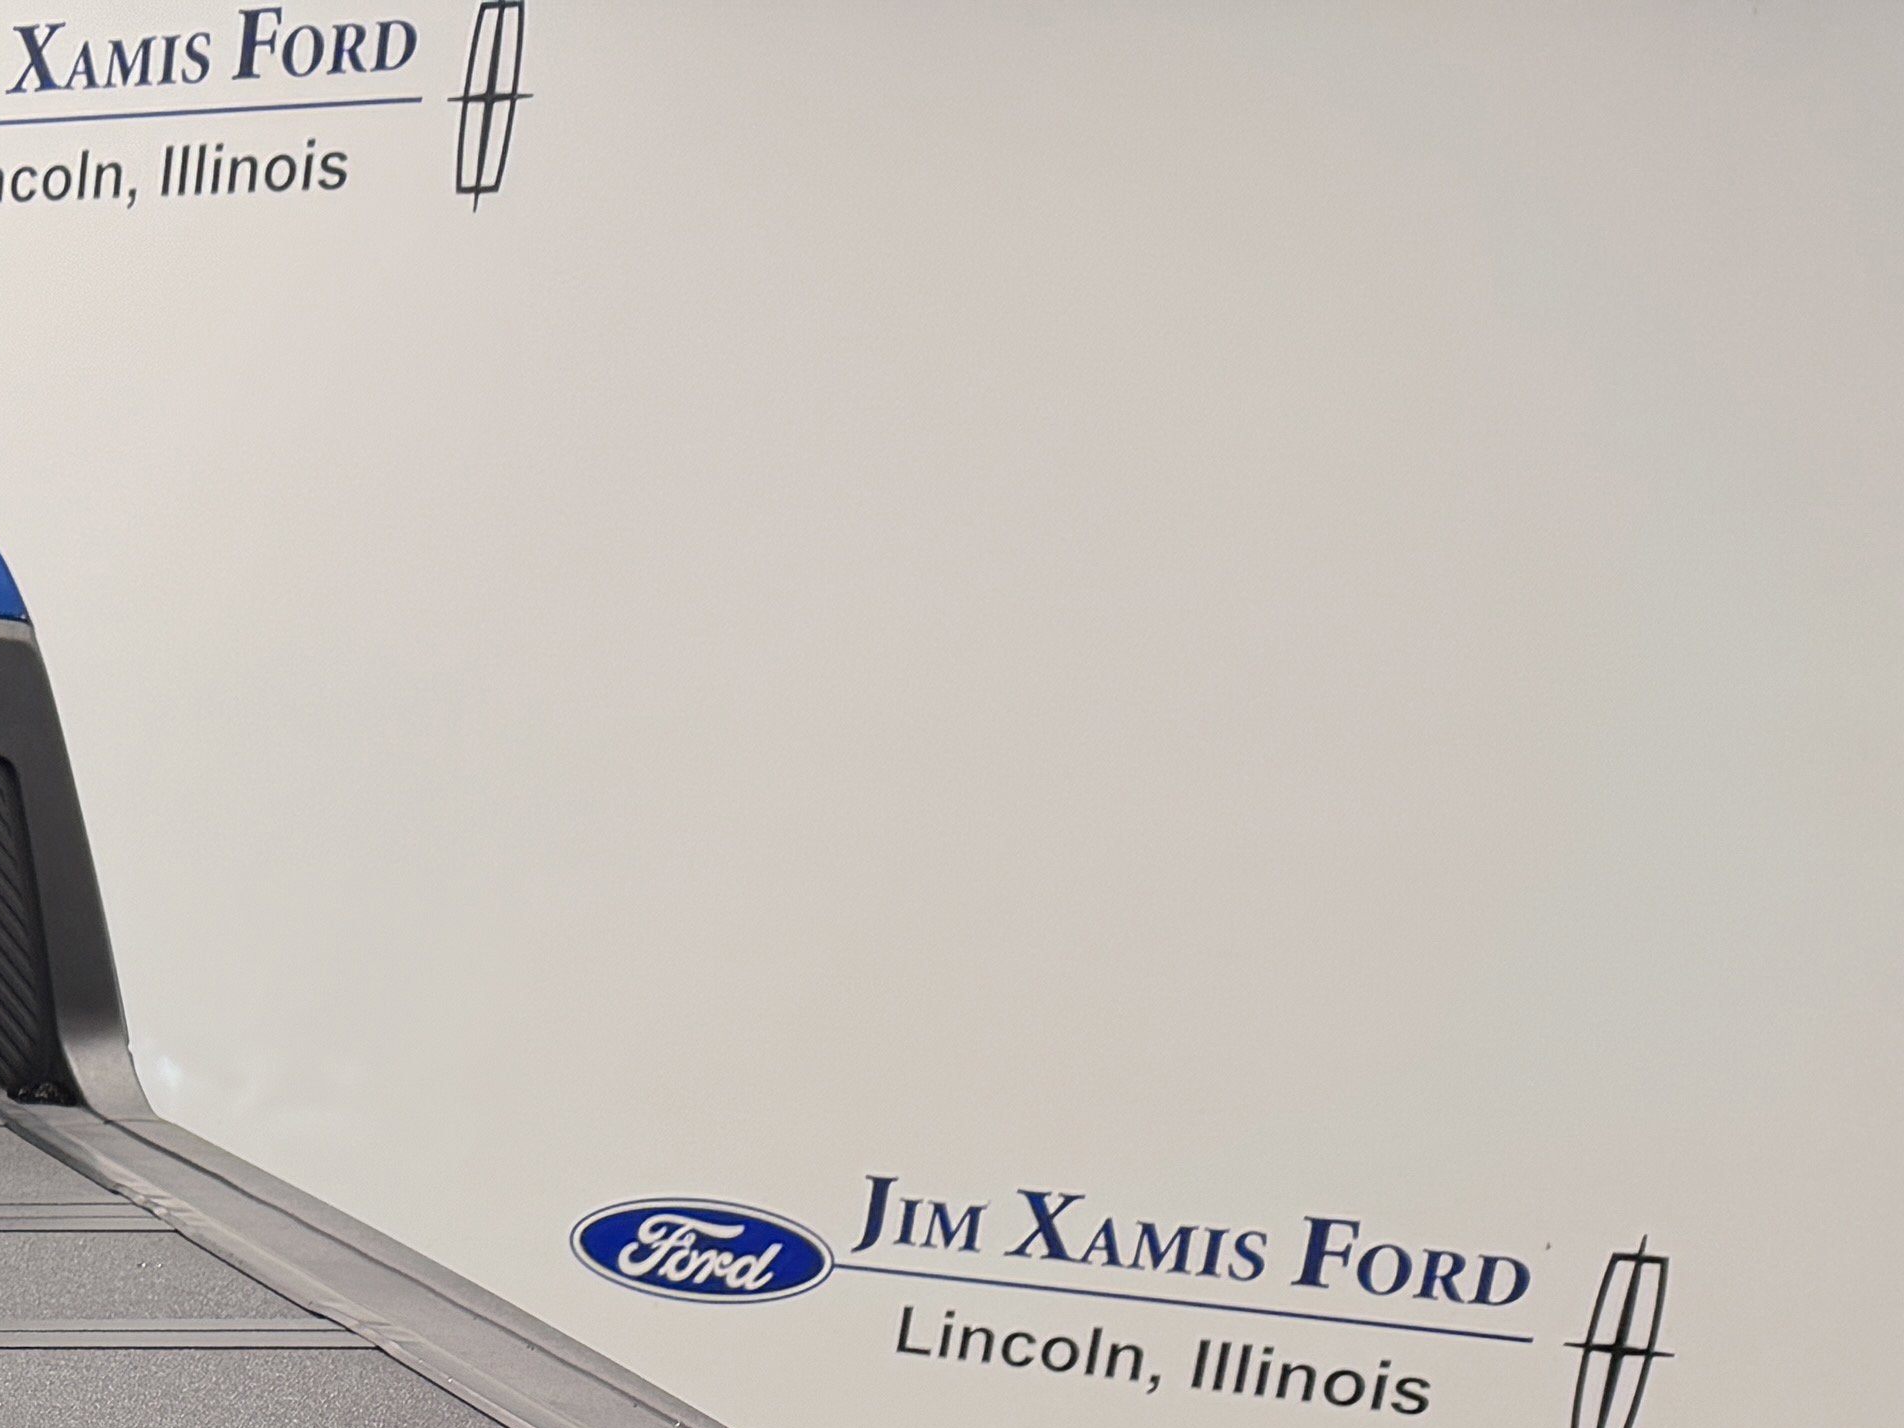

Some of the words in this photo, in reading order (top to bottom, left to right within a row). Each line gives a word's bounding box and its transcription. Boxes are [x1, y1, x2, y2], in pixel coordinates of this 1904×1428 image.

[5, 21, 211, 95] XAMIS
[231, 6, 419, 81] FORD
[159, 138, 349, 199] Illinois
[617, 1213, 783, 1291] Ford
[850, 1173, 988, 1254] JIM
[1003, 1187, 1269, 1282] XAMIS
[1289, 1214, 1532, 1308] FORD
[895, 1305, 1162, 1396] Lincoln,
[1189, 1338, 1432, 1417] Illinois
